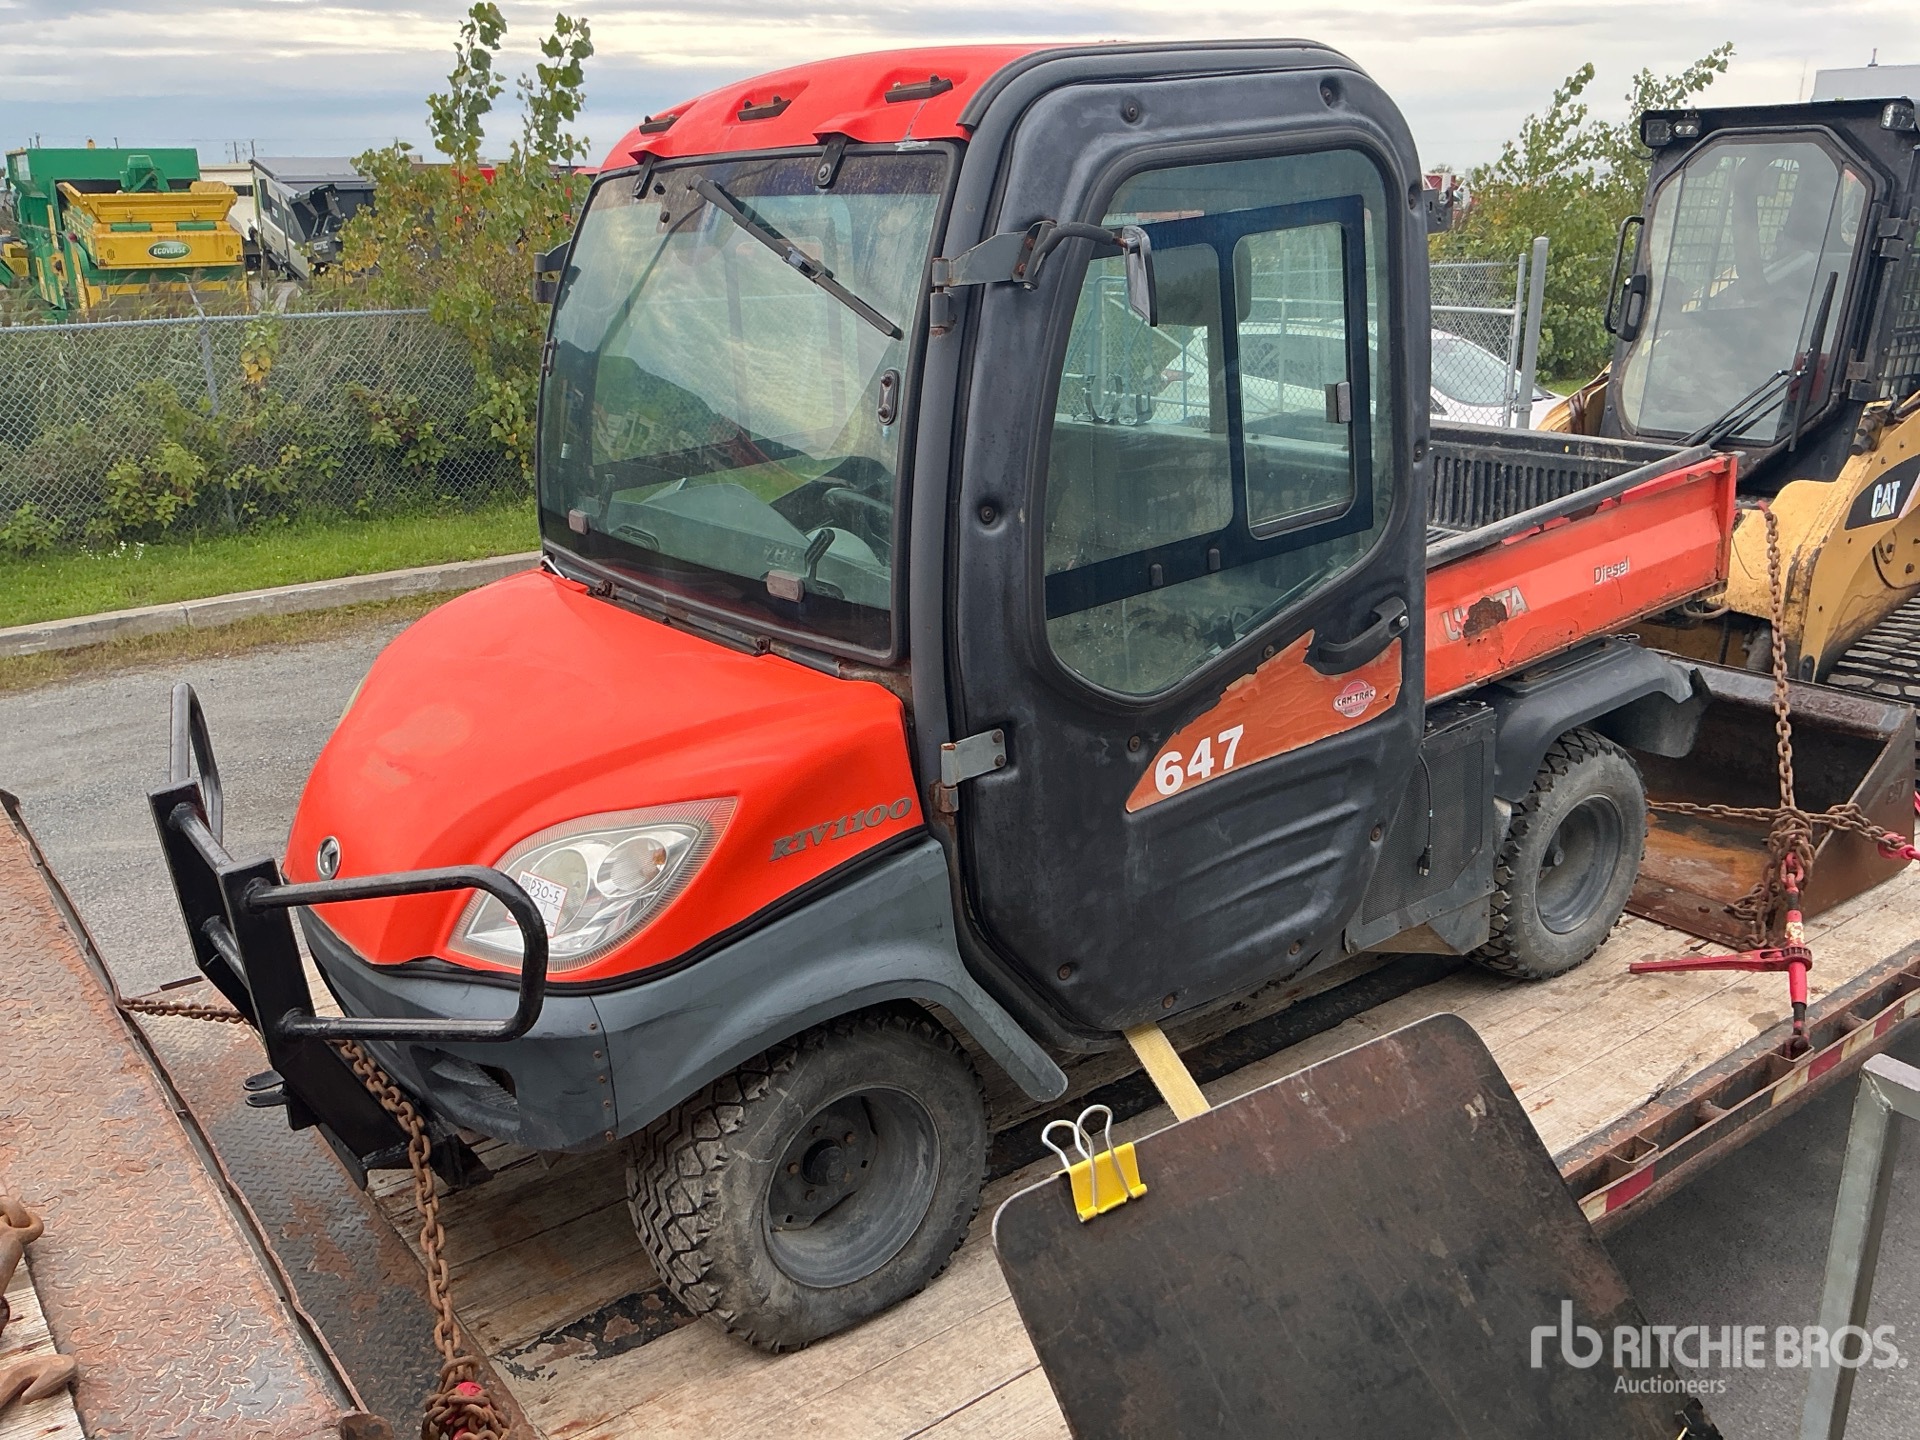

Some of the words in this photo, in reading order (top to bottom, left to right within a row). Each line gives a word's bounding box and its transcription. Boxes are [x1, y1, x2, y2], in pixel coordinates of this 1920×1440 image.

[153, 246, 187, 255] ECOVERSE
[1871, 480, 1901, 518] CAT
[1593, 555, 1630, 584] Diesel
[1336, 689, 1374, 706] CAM-TRAC
[1155, 723, 1244, 795] 647
[769, 797, 912, 862] RTV1100
